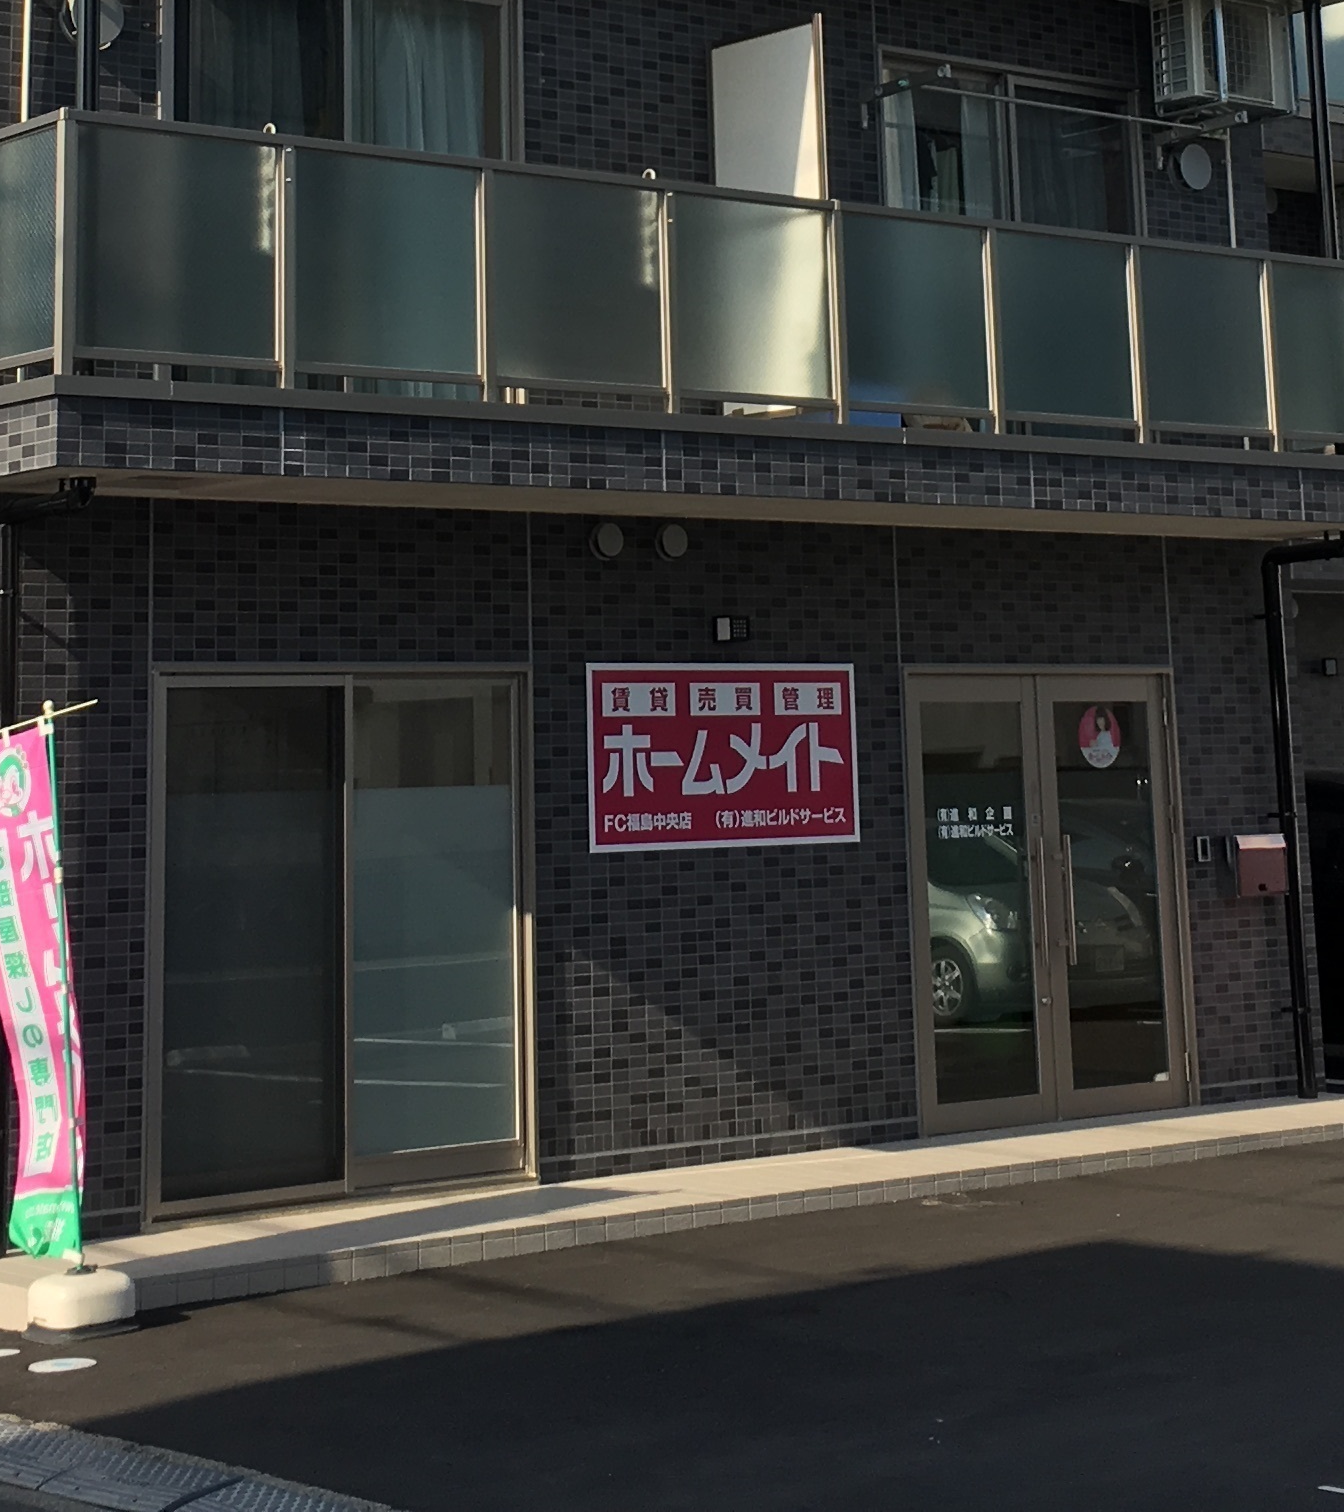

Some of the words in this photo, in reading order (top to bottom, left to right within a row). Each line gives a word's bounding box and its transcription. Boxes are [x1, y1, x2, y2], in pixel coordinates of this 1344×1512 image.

[611, 687, 668, 712] 賃貸
[698, 686, 753, 712] 売買
[782, 687, 835, 711] 管理
[602, 722, 844, 797] ホームメイト
[604, 812, 692, 832] FC福島中央店
